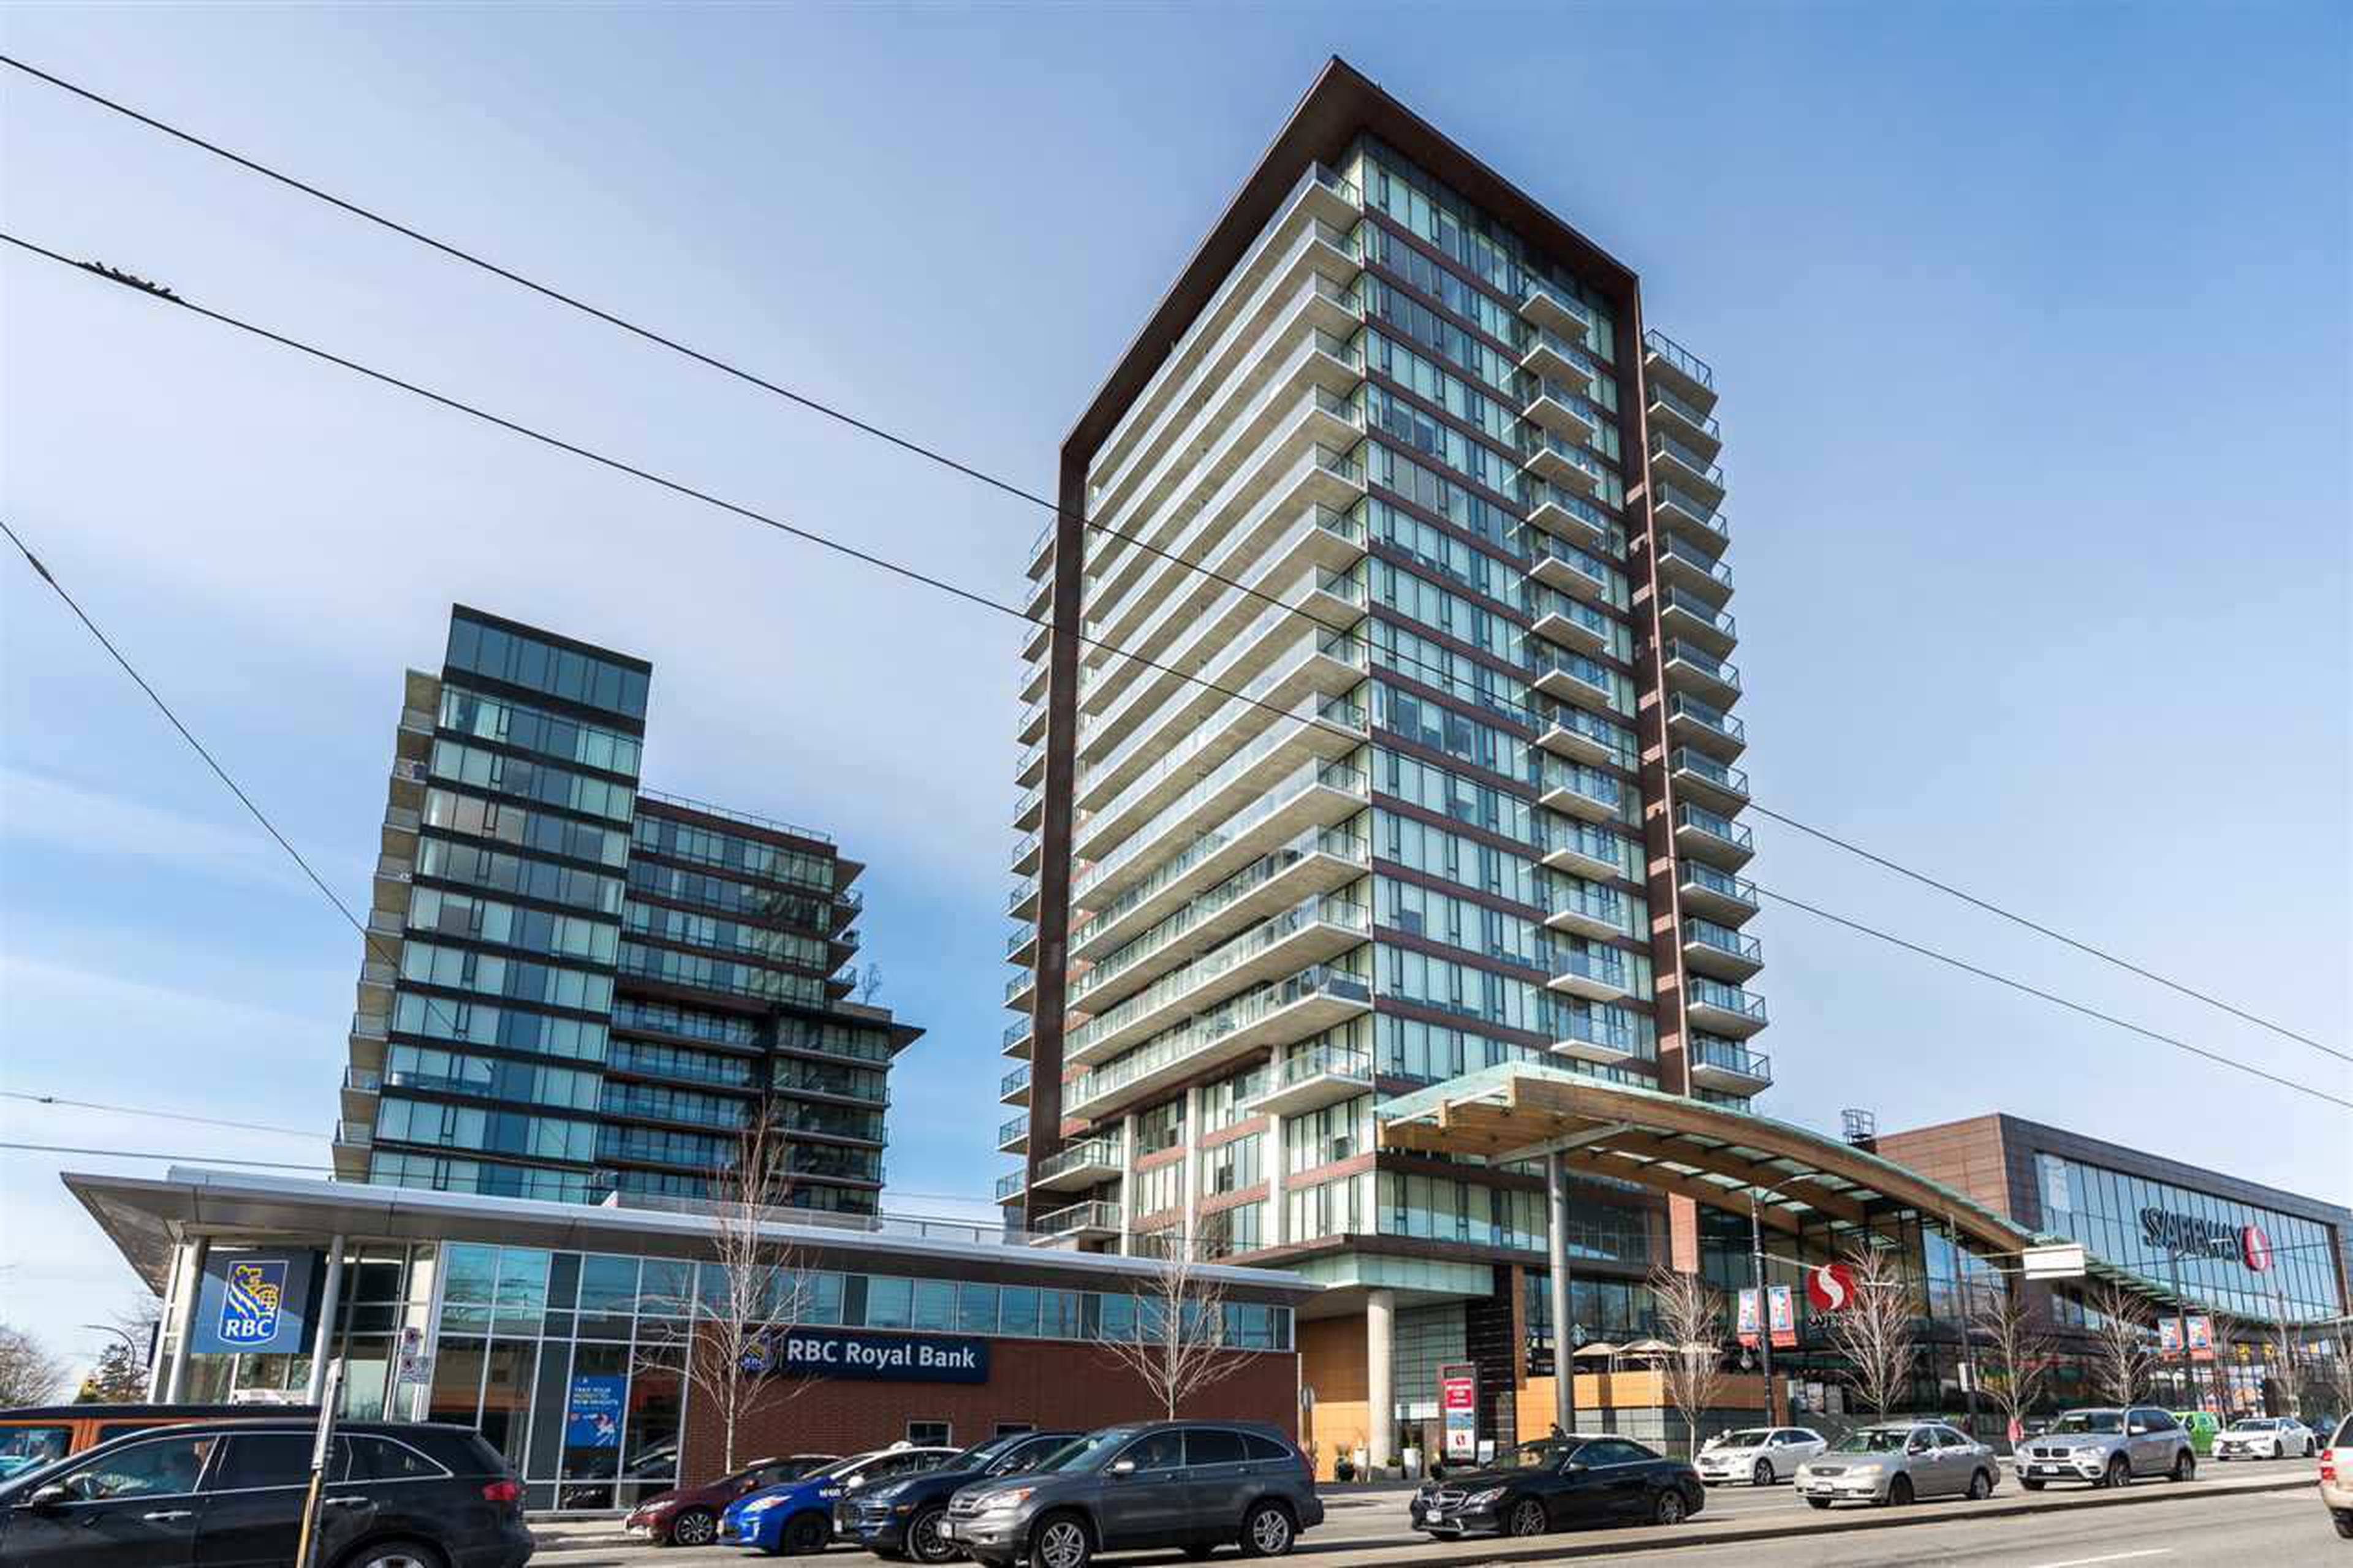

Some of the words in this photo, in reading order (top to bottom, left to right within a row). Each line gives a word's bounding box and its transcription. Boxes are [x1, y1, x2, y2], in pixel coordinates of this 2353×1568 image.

[225, 1319, 273, 1337] RBC
[786, 1339, 838, 1363] RBC
[846, 1343, 911, 1369] Royal
[919, 1346, 976, 1368] Bank
